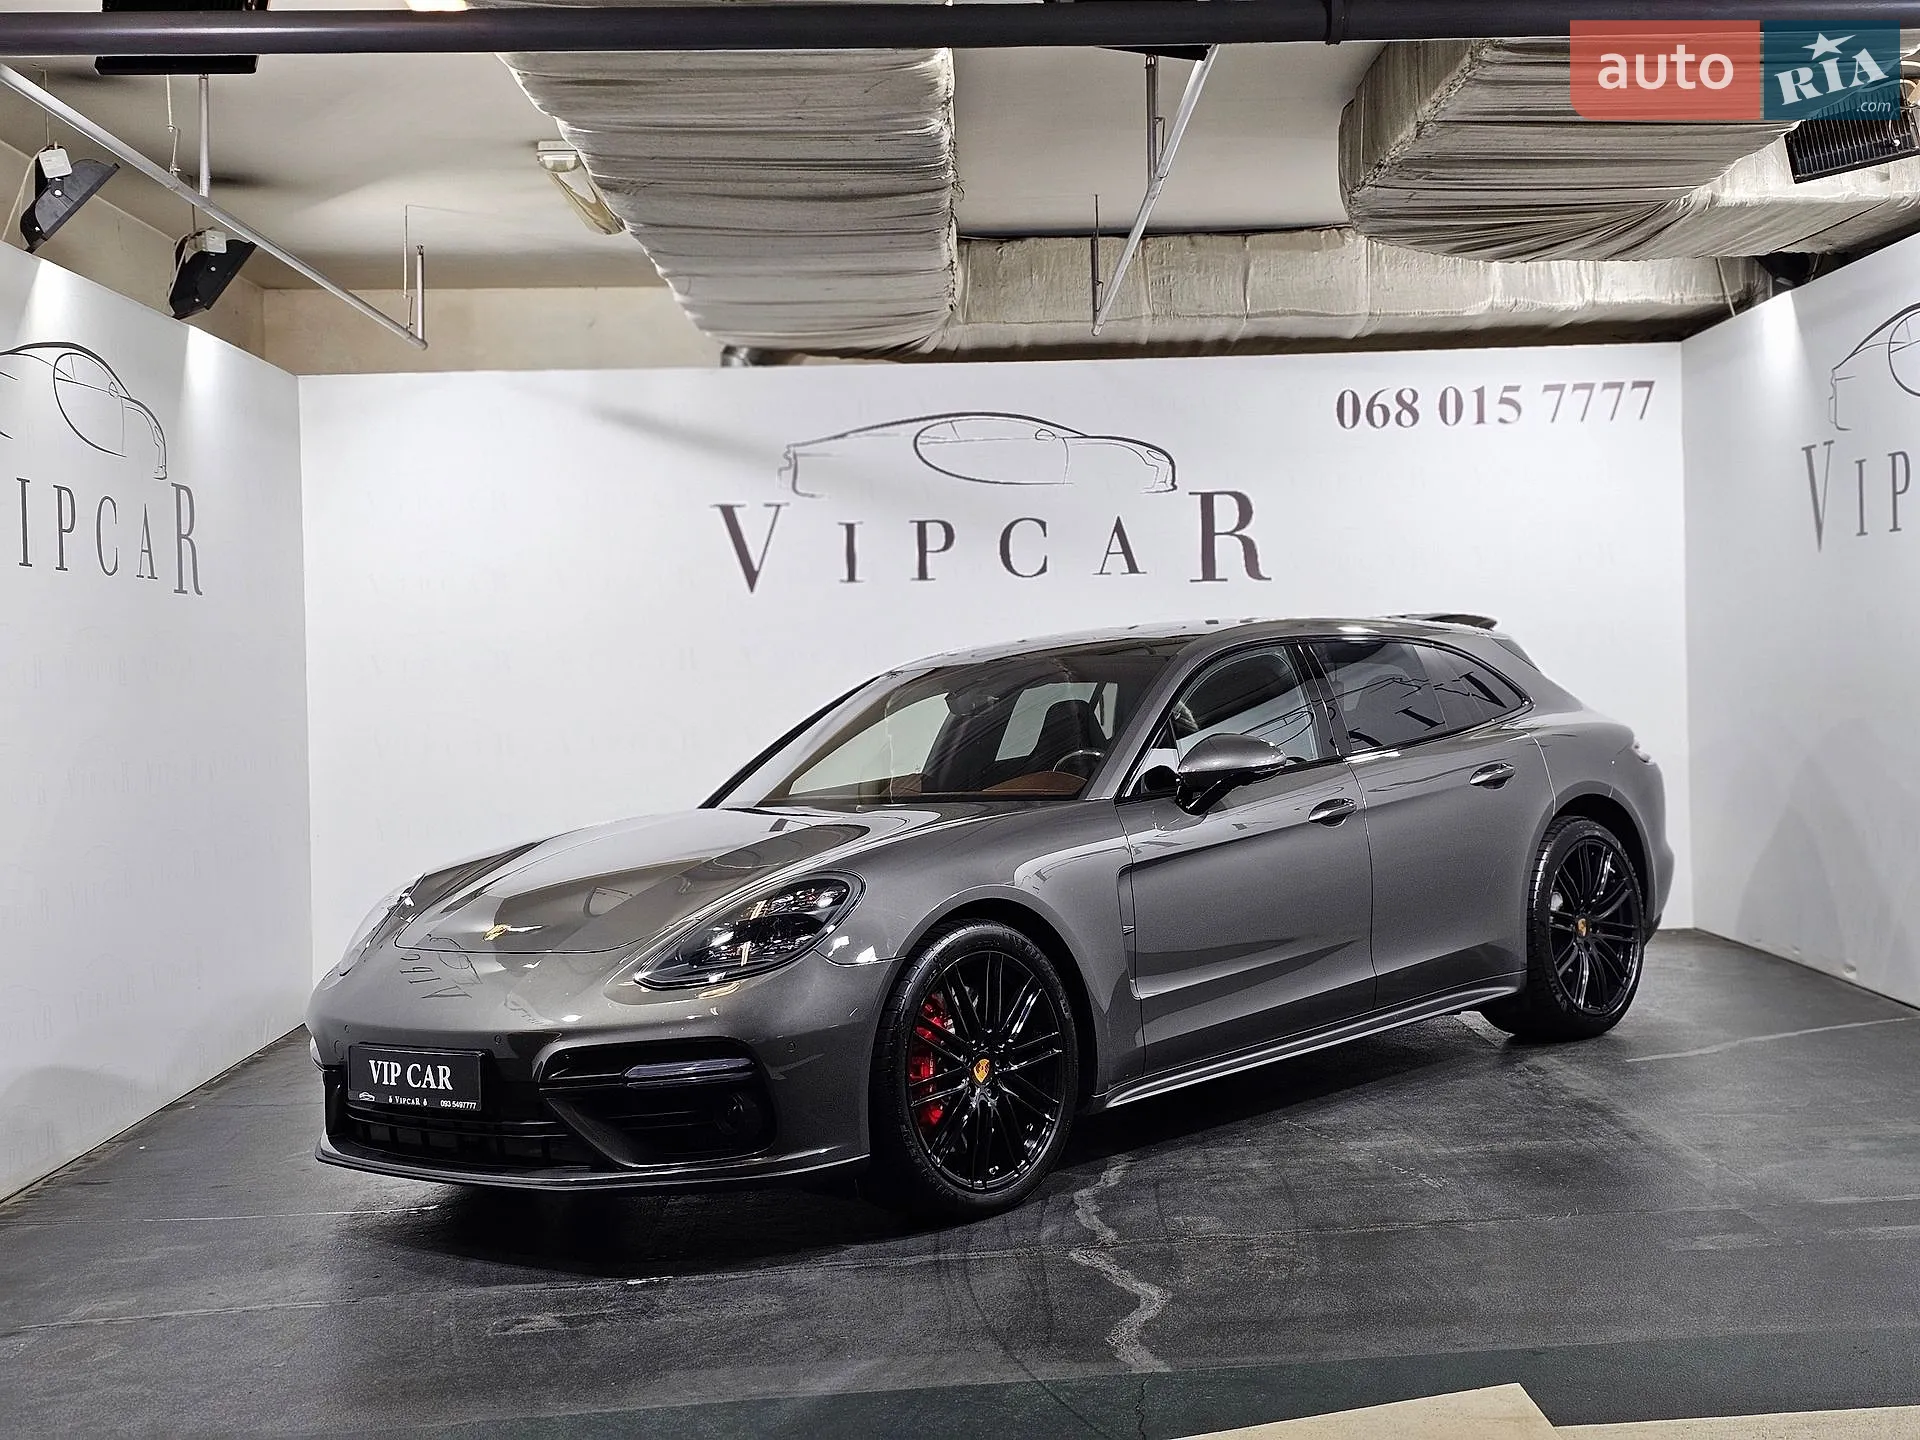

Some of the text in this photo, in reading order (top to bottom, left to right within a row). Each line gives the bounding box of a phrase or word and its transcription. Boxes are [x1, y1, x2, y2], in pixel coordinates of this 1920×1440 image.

[1336, 380, 1656, 430] 068 015 7777
[368, 1059, 454, 1091] VIP CAR
